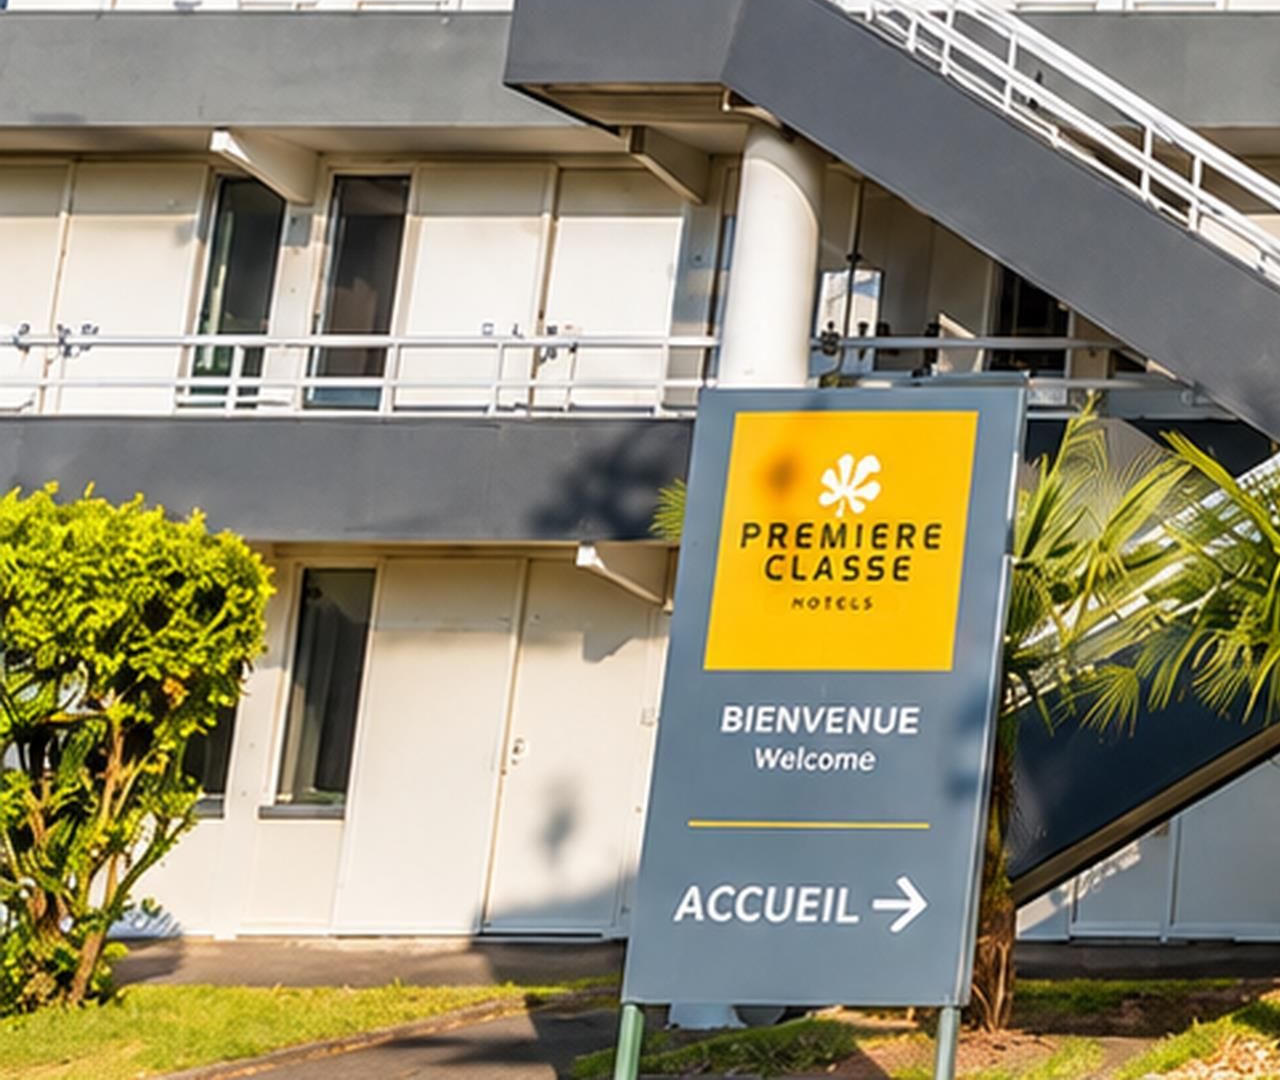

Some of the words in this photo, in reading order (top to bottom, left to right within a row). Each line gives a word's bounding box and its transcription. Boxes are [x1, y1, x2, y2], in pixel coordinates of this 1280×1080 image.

[739, 522, 943, 550] PREMIERE
[764, 553, 911, 583] CLASSE
[720, 705, 921, 735] BIENVENUE
[754, 745, 876, 772] Welcome
[673, 884, 860, 925] ACCUEIL
